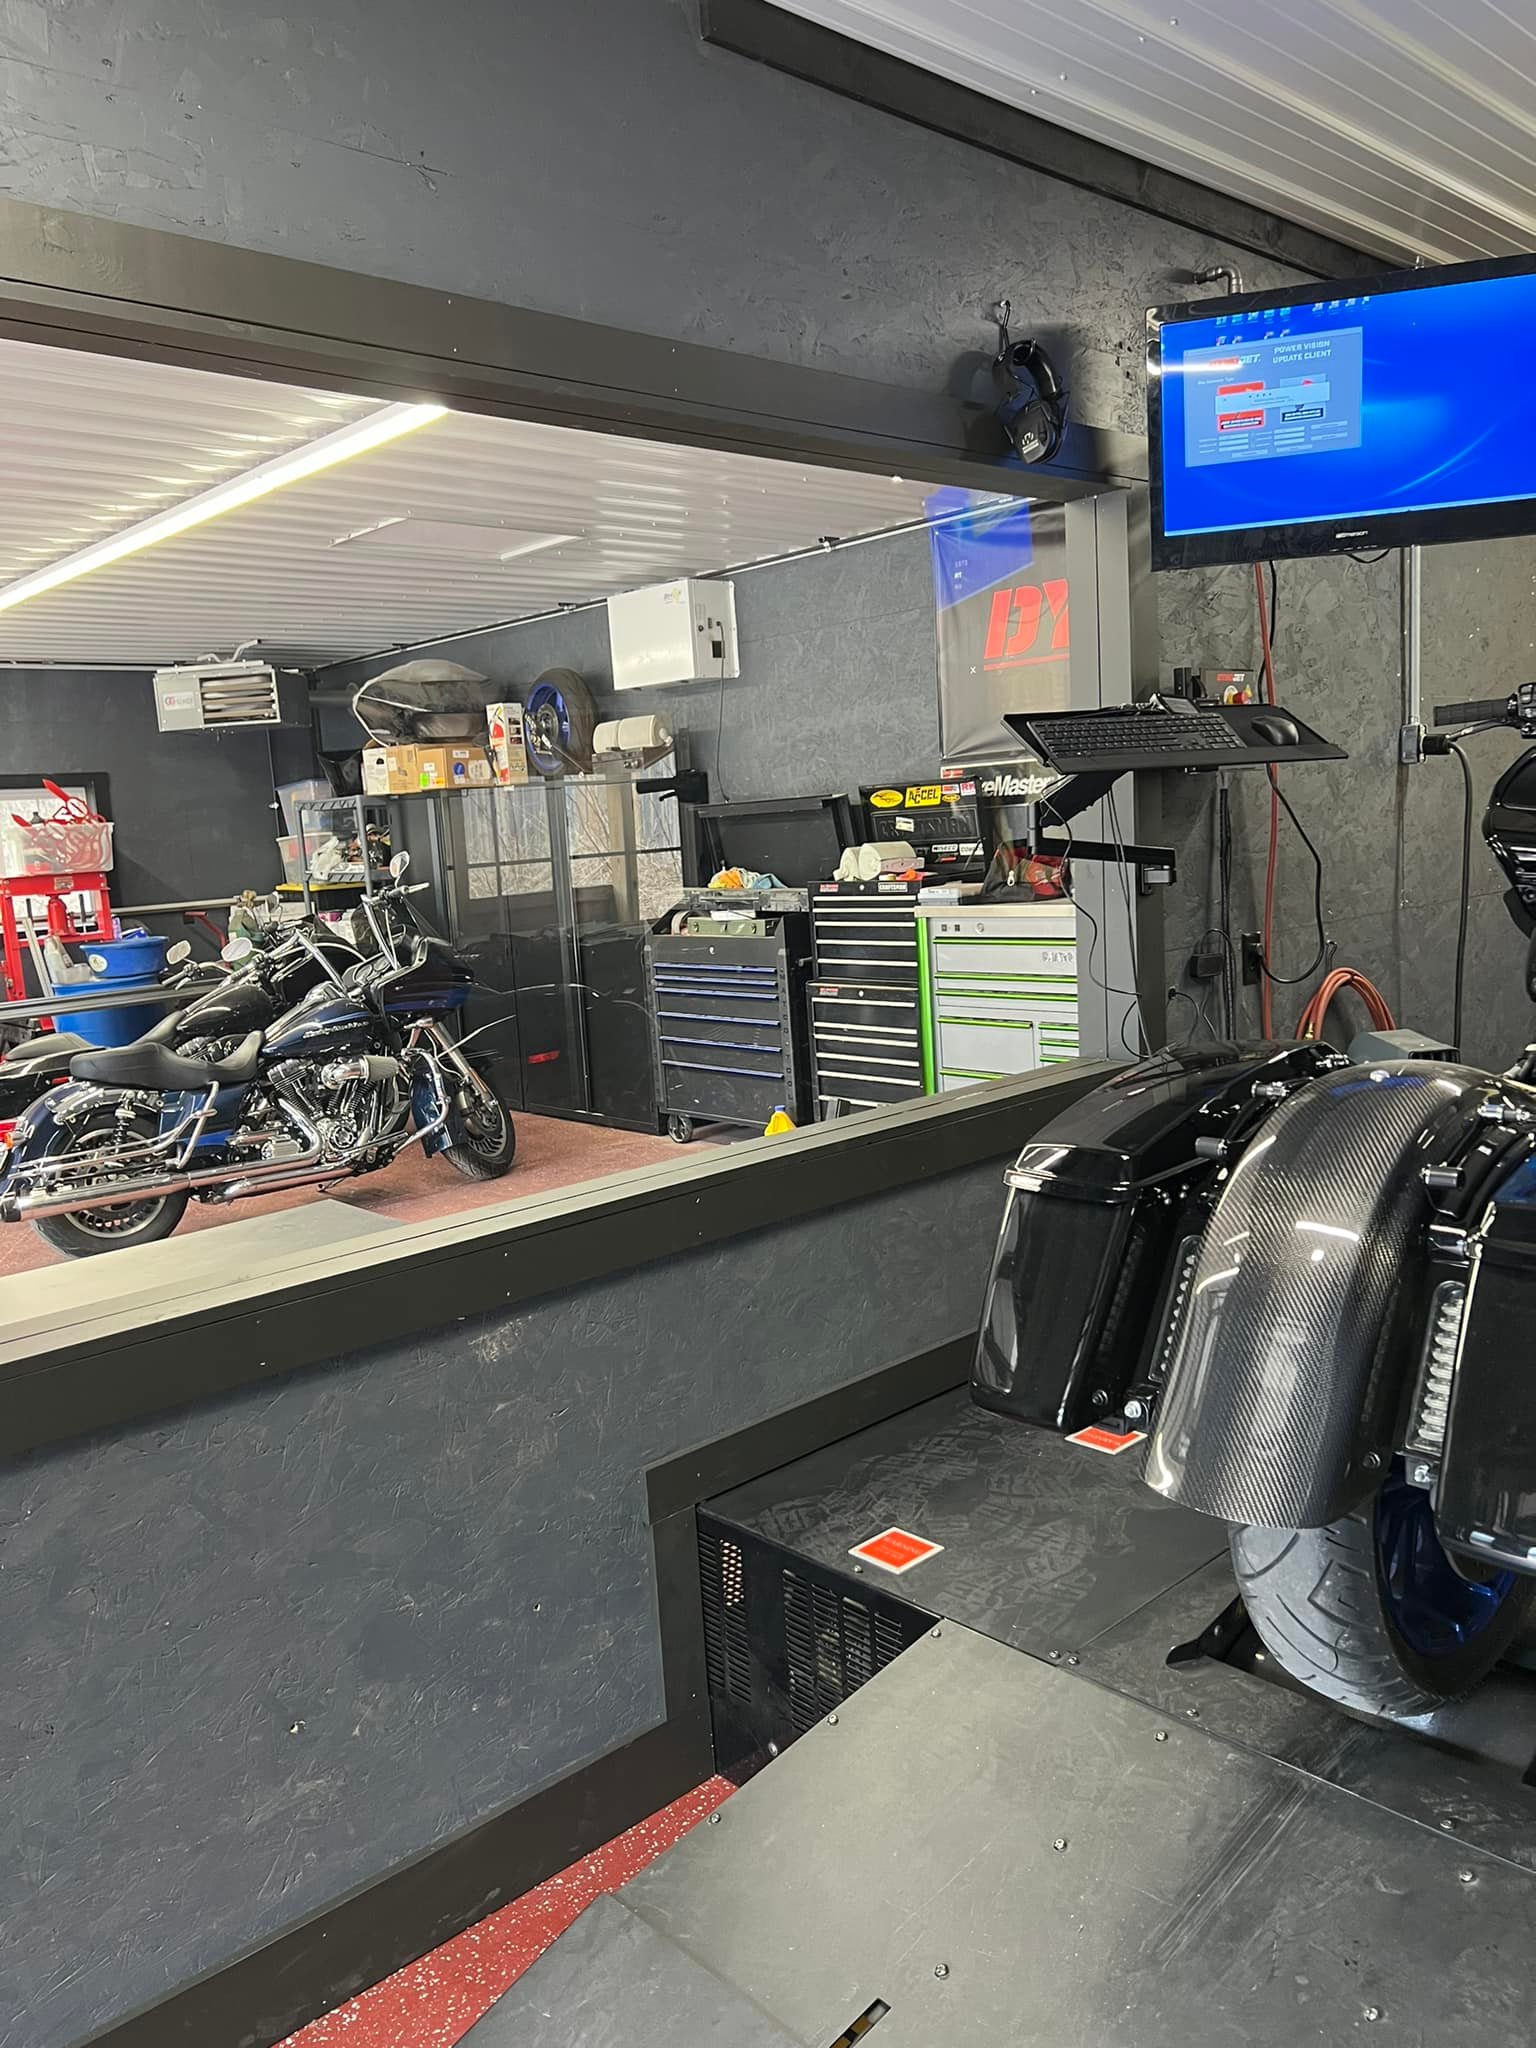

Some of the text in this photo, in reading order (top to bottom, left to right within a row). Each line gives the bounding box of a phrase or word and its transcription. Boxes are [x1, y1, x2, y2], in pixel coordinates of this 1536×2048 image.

[1273, 339, 1330, 354] POWER VISION
[1272, 349, 1332, 364] UPDATE CLIENT
